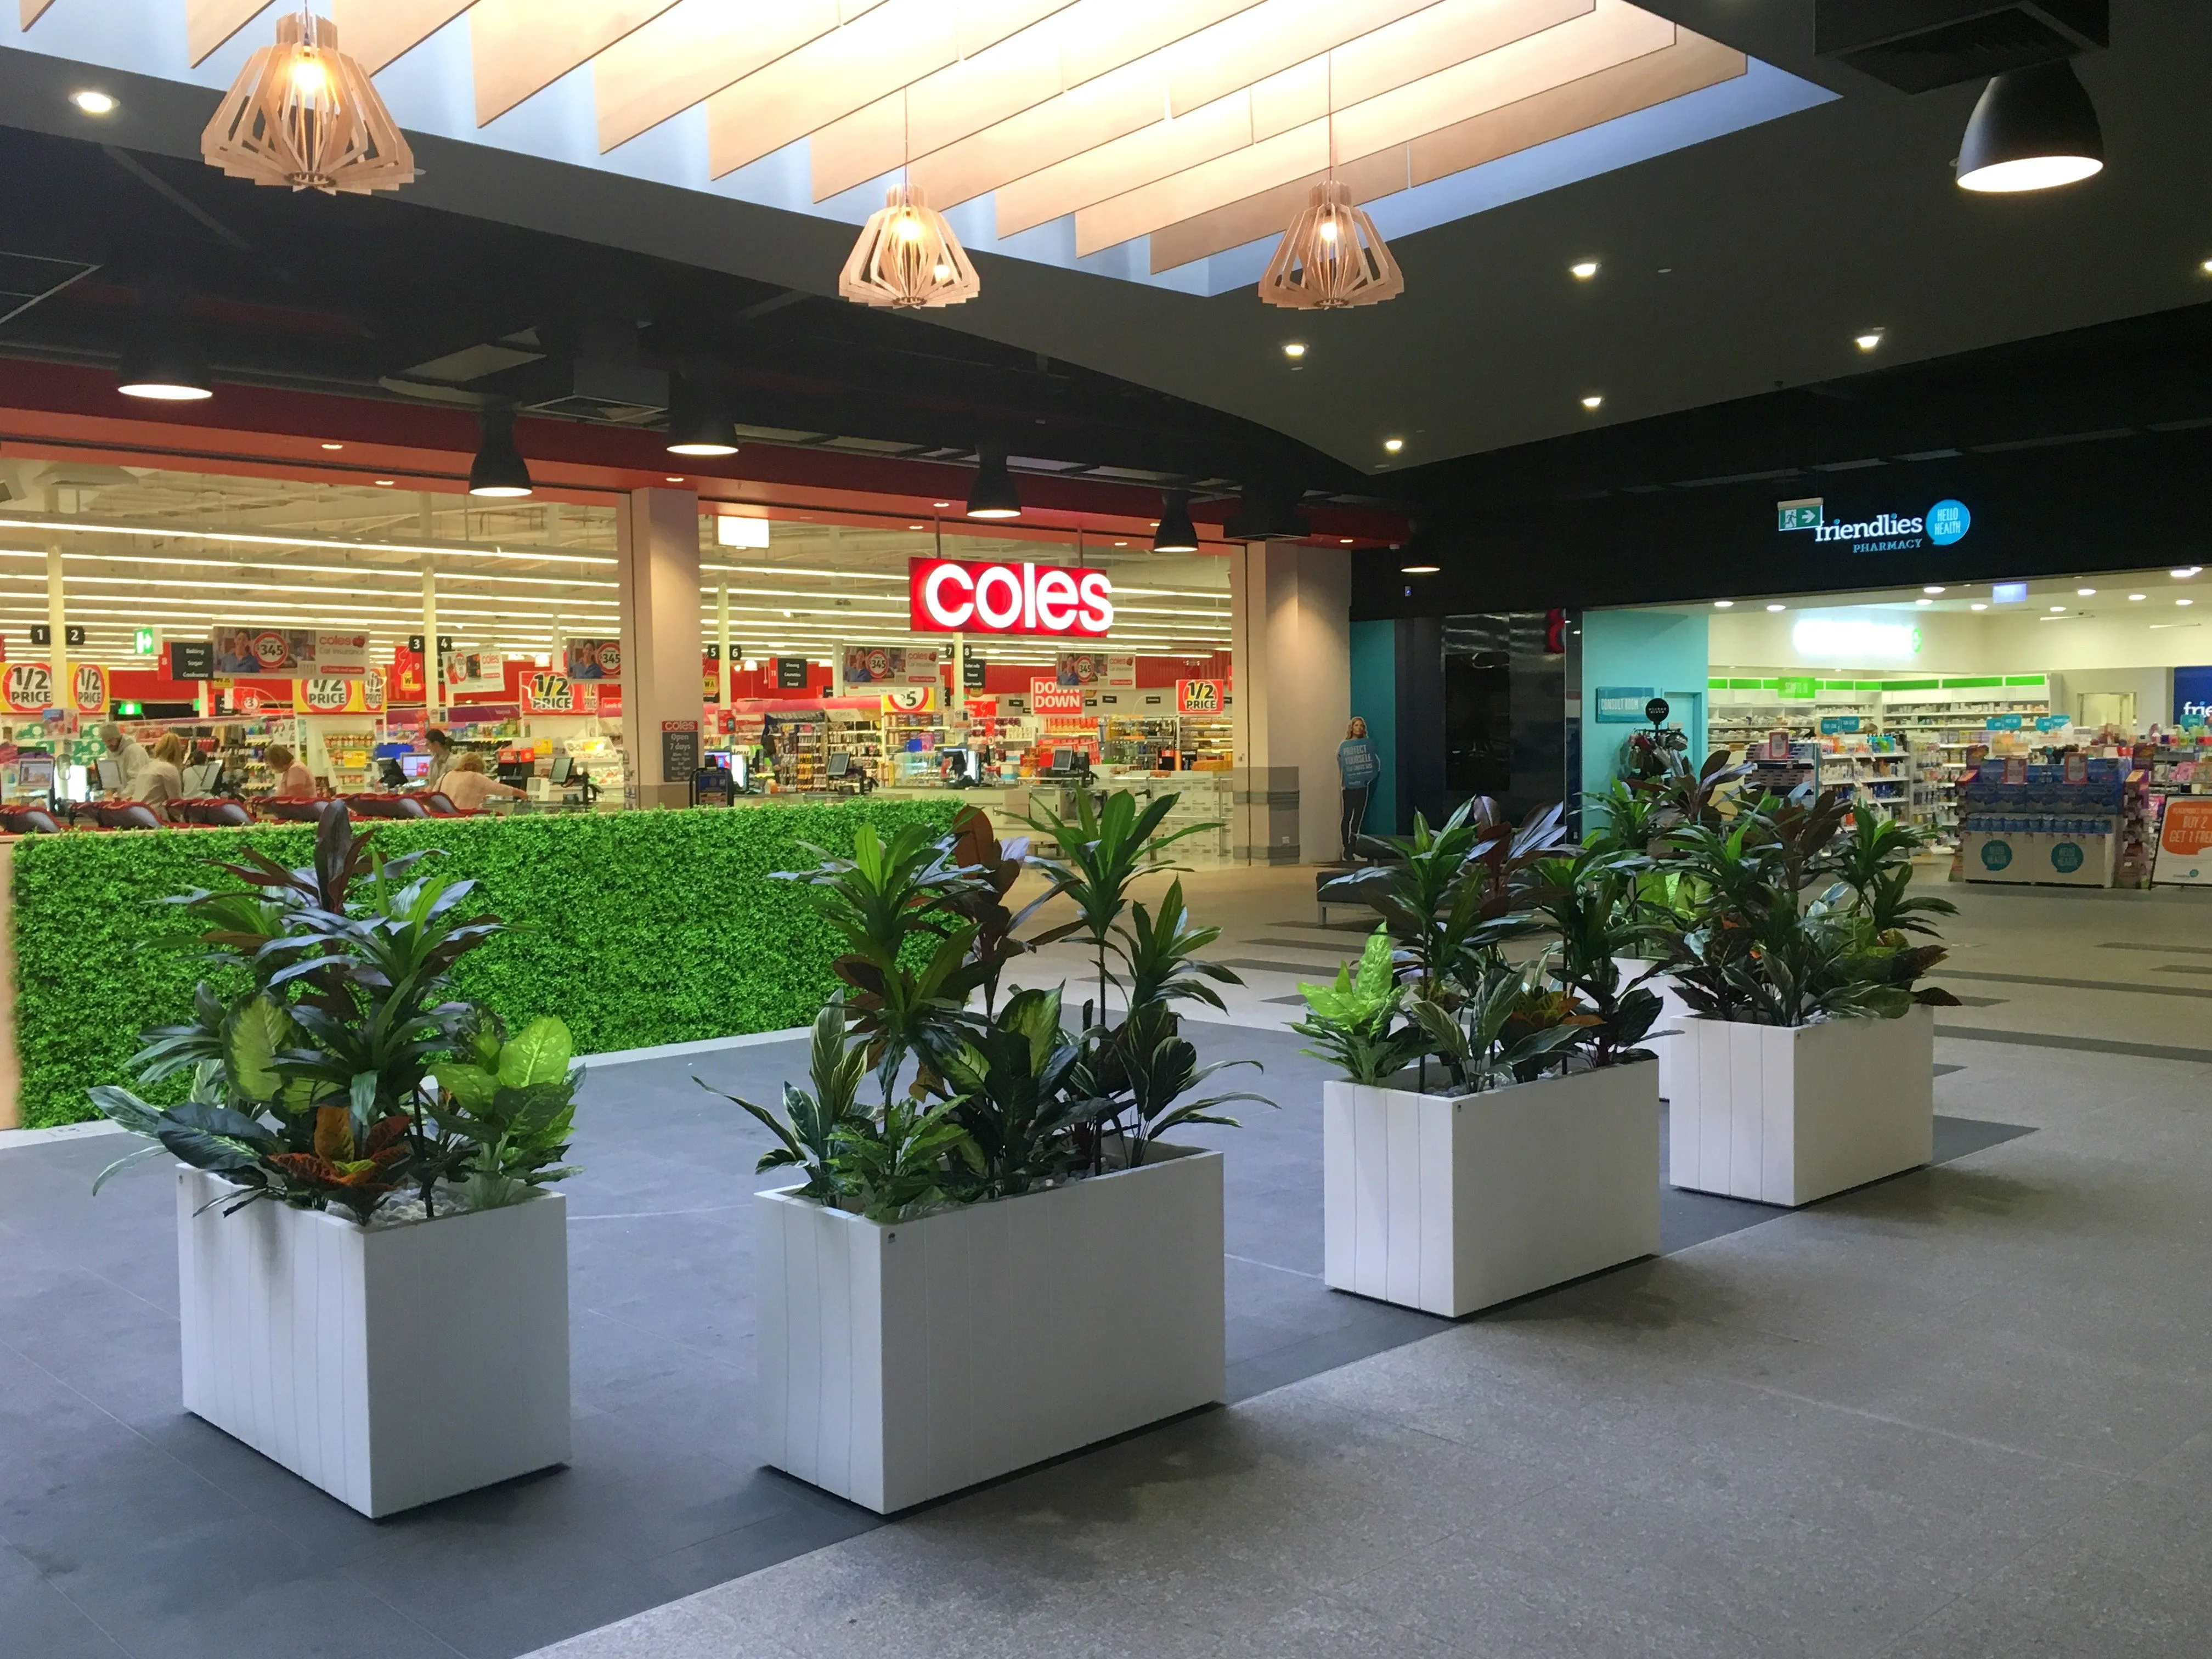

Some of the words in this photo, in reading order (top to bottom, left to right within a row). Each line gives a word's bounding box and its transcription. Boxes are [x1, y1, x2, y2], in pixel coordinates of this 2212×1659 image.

[1938, 507, 1958, 521] HELLO
[1815, 514, 1923, 541] friendlies
[1934, 521, 1961, 535] HEALTH
[1853, 538, 1923, 553] PHARMACY
[926, 562, 1114, 631] coles
[37, 629, 43, 640] 1
[71, 630, 78, 641] 2
[319, 635, 351, 645] coles
[413, 639, 420, 649] 3
[441, 638, 447, 648] 4
[710, 648, 716, 657] 5
[732, 648, 738, 657] 6
[907, 651, 928, 659] coles
[13, 667, 48, 690] 1/2
[78, 668, 100, 691] 1/2
[534, 674, 569, 696] 1/2
[1188, 681, 1214, 699] 1/2
[11, 691, 51, 703] PRICE
[78, 692, 101, 703] PRICE
[309, 693, 345, 703] PRICE
[365, 693, 381, 704] PRICE
[533, 697, 571, 708] PRICE
[1035, 695, 1080, 708] DOWN
[584, 698, 596, 708] PRICE
[1187, 700, 1216, 709] PRICE
[1601, 698, 1623, 710] CONSULT
[1625, 698, 1638, 710] ROOM
[665, 721, 695, 731] coles
[671, 733, 689, 742] Open
[675, 742, 691, 751] days
[2182, 816, 2199, 828] BUY
[2200, 816, 2208, 829] 2
[2169, 830, 2186, 843] GET
[2189, 831, 2193, 843] 1
